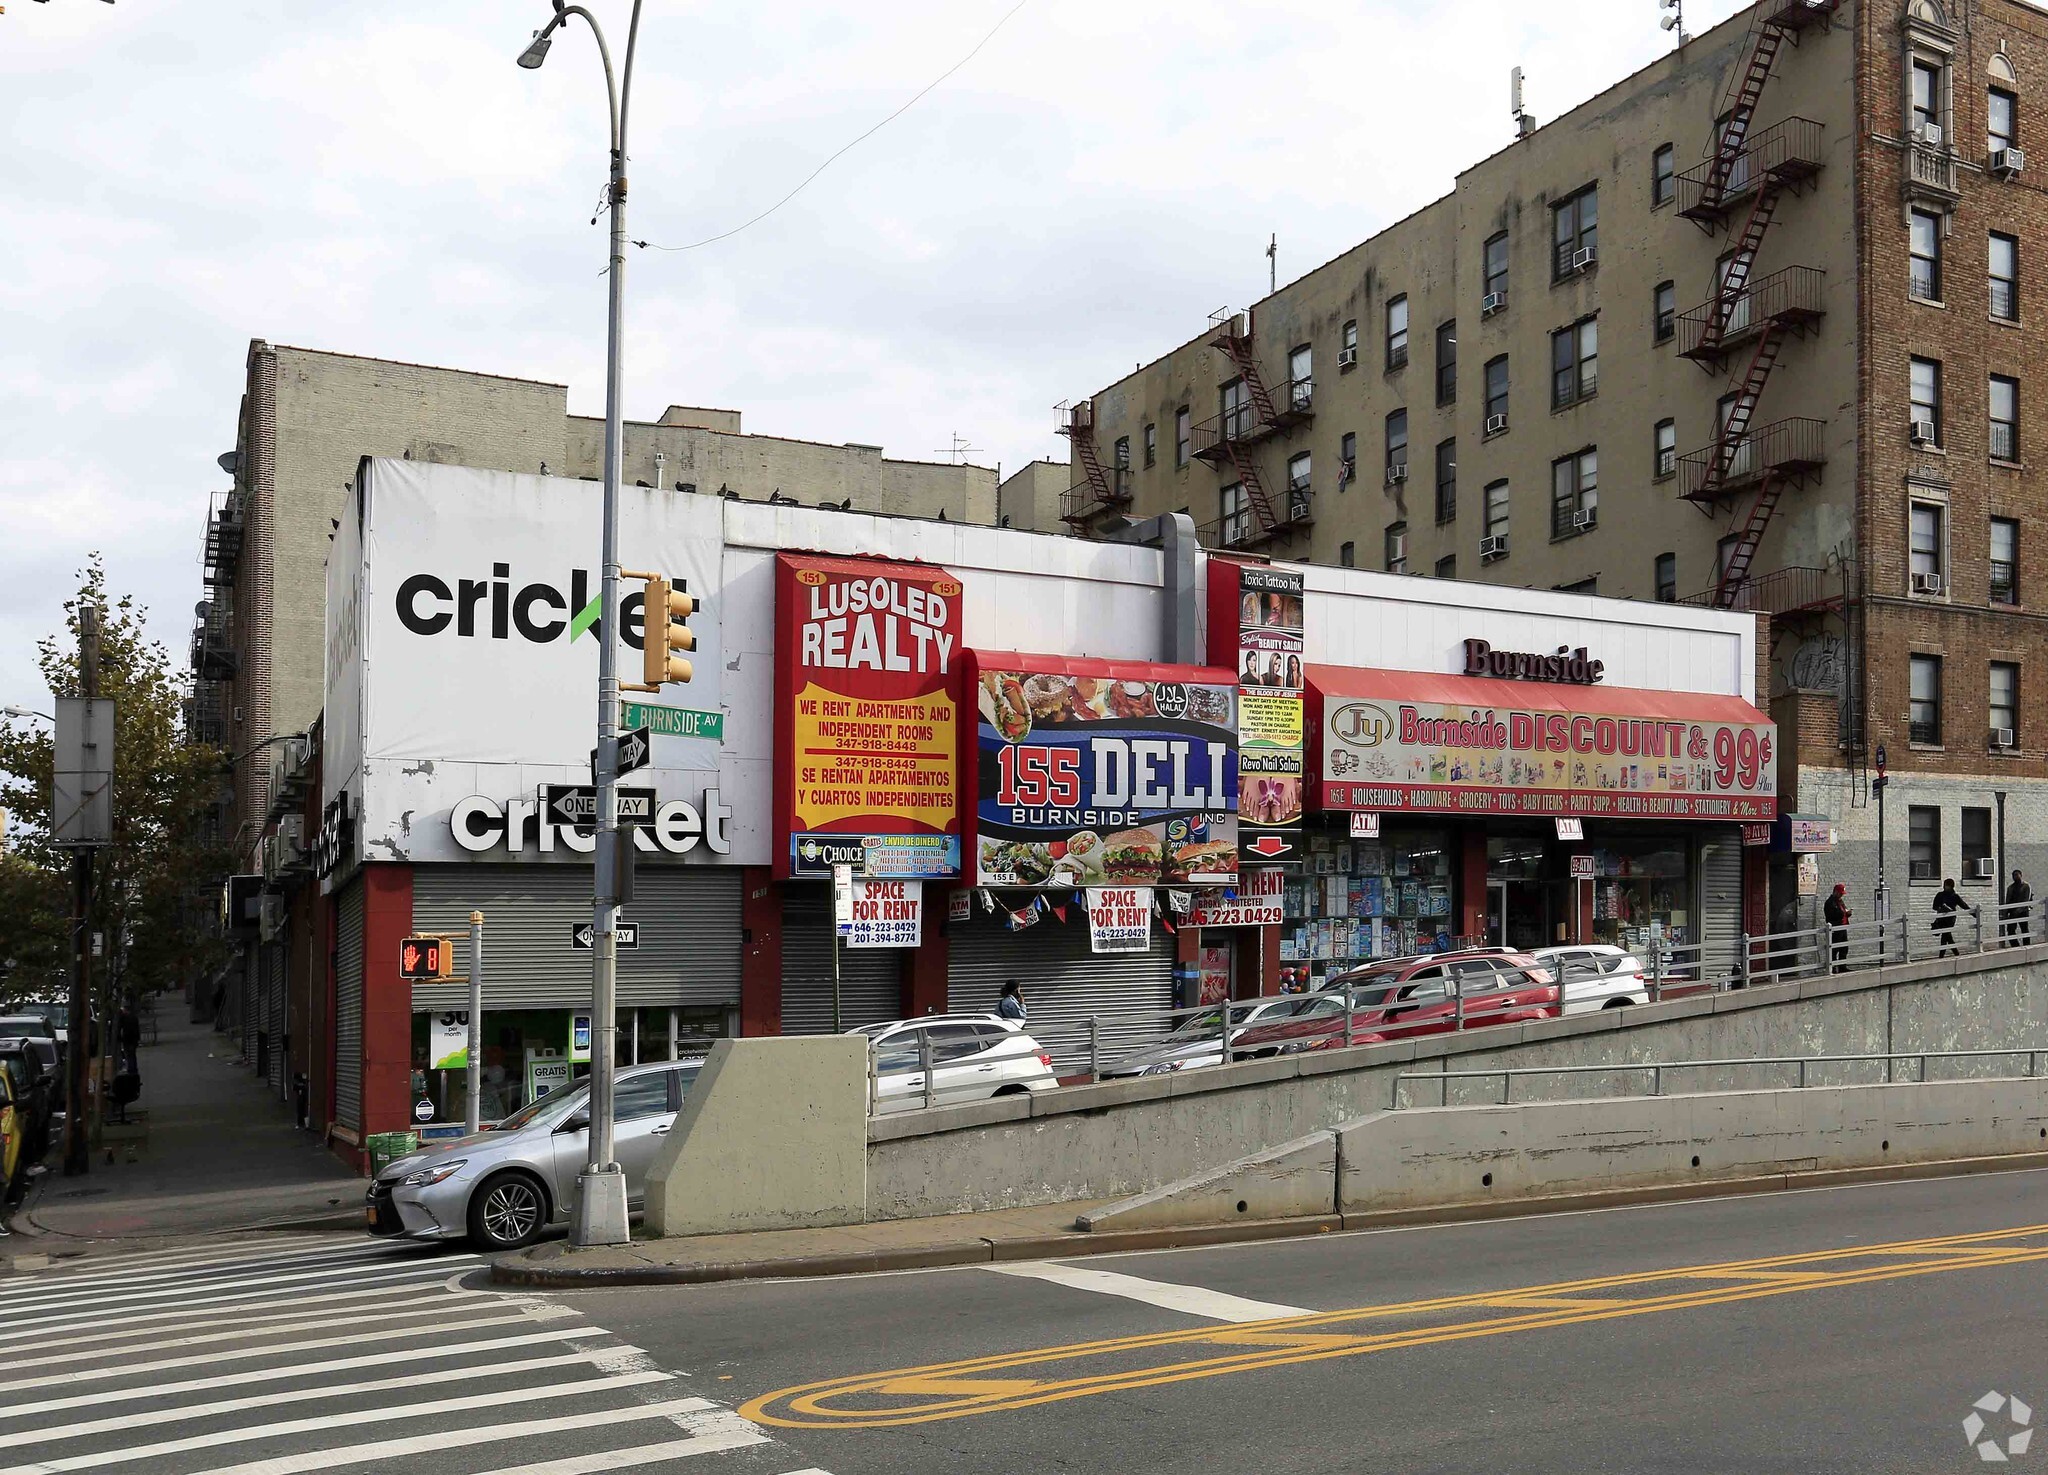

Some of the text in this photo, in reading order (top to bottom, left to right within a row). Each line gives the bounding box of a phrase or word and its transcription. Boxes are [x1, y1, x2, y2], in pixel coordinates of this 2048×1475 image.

[802, 572, 820, 584] 151
[1244, 572, 1301, 592] Toxic Tattoo Ink
[938, 584, 956, 594] 151
[810, 576, 948, 628] LUSOLED
[802, 613, 954, 675] REALTY
[1258, 638, 1283, 650] BEAUTY
[1282, 640, 1302, 652] SALON
[1464, 638, 1604, 683] Burnside
[1156, 685, 1186, 704] حلال
[800, 700, 950, 722] WE RENT APARTMENTS AND
[1160, 704, 1182, 712] HALAL
[625, 706, 718, 735] E BURNSIDE AV
[818, 721, 933, 741] INDEPENDENT ROOMS
[622, 741, 641, 763] WAY
[836, 738, 917, 751] 347-918-8448
[1400, 705, 1772, 790] Burnside DISCOUNT & 99¢
[836, 757, 917, 770] 347-918-8449
[1242, 757, 1300, 773] Revo Nail Salon
[802, 768, 950, 786] SE RENTAN APARTAMENTOS
[998, 745, 1080, 808] 155
[1092, 738, 1227, 810] DELI
[564, 798, 595, 813] ONE
[798, 790, 954, 808] Y CUARTOS INDEPENDIENTES
[1352, 788, 1402, 806] HOUSEHOLDS
[1410, 790, 1452, 808] HARDWARE
[1459, 792, 1492, 809] GROCERY
[1498, 793, 1516, 810] TOYS
[1522, 794, 1541, 810] BABY
[1542, 794, 1563, 811] ITEMS
[1570, 795, 1592, 811] PARTY
[1592, 796, 1611, 812] SUPP.
[1617, 796, 1641, 812] HEALTH
[1642, 797, 1648, 812] &
[1650, 797, 1674, 814] BEAUTY
[1674, 798, 1688, 814] AIDS
[1694, 798, 1731, 815] STATIONERY
[1732, 800, 1738, 816] &
[1740, 801, 1758, 816] More
[1012, 808, 1226, 826] BURNSIDE INC
[1352, 813, 1377, 830] ATM
[1558, 818, 1580, 834] ATM
[1752, 824, 1768, 838] ATM
[862, 838, 882, 847] GRATIS
[885, 836, 940, 847] ENVIO DE DINERO
[822, 845, 864, 864] CHOICE
[1579, 858, 1592, 872] ATM
[865, 882, 905, 900] SPACE
[1252, 872, 1284, 896] RENT
[950, 900, 969, 911] ATM
[1100, 890, 1136, 908] SPACE
[852, 900, 918, 920] FOR RENT
[1090, 908, 1148, 928] FOR RENT
[854, 922, 916, 932] 646-223-0429
[1092, 928, 1146, 939] 646-223-0429
[854, 933, 916, 943] 201-394-8774
[428, 948, 437, 971] 8
[535, 1066, 567, 1077] GRATIS
